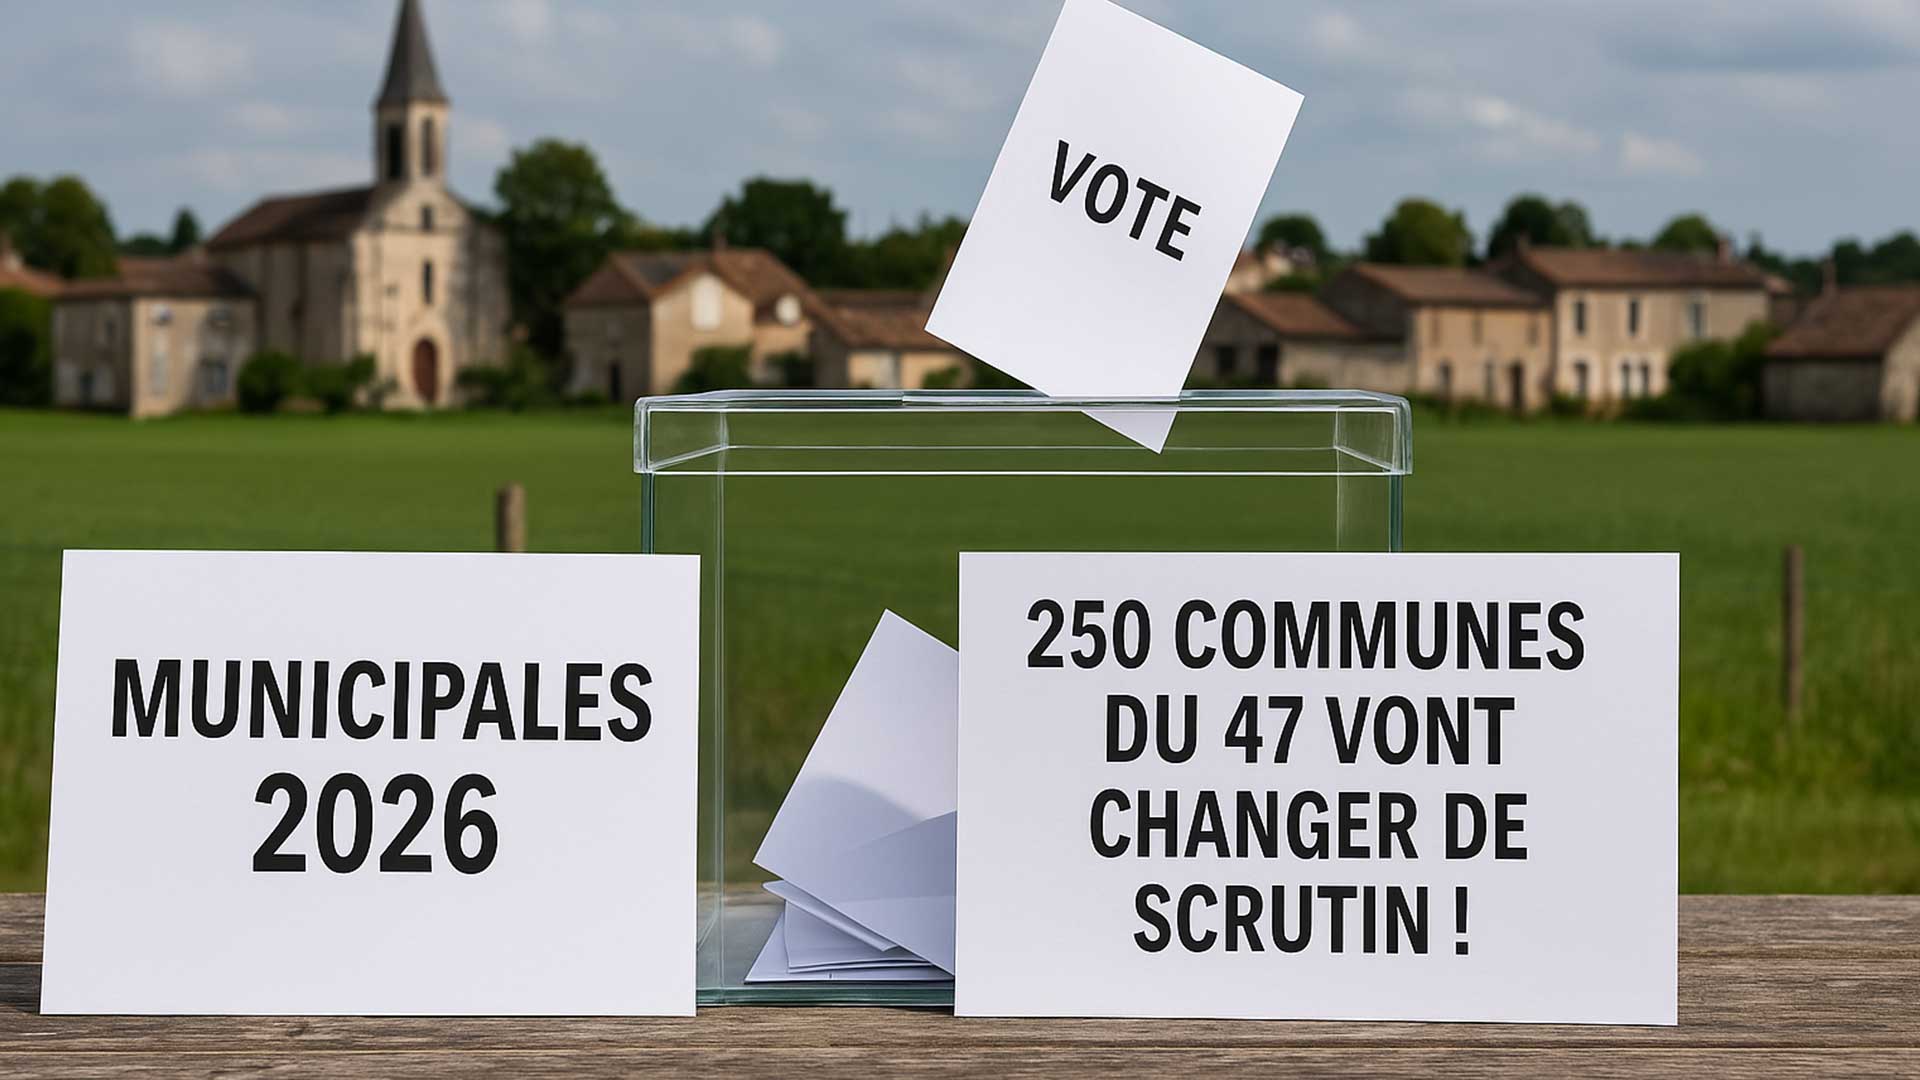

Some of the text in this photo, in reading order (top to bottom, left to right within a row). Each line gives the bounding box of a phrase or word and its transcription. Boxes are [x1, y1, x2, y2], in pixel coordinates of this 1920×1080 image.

[1050, 139, 1202, 262] VOTE
[1027, 598, 1585, 671] 250 COMMUNES
[111, 658, 653, 743] MUNICIPALES
[1106, 694, 1515, 765] DU 47 VONT
[252, 772, 498, 875] 2026
[1090, 788, 1528, 860] CHANGER DE
[1133, 883, 1469, 956] SCRUTIN !
